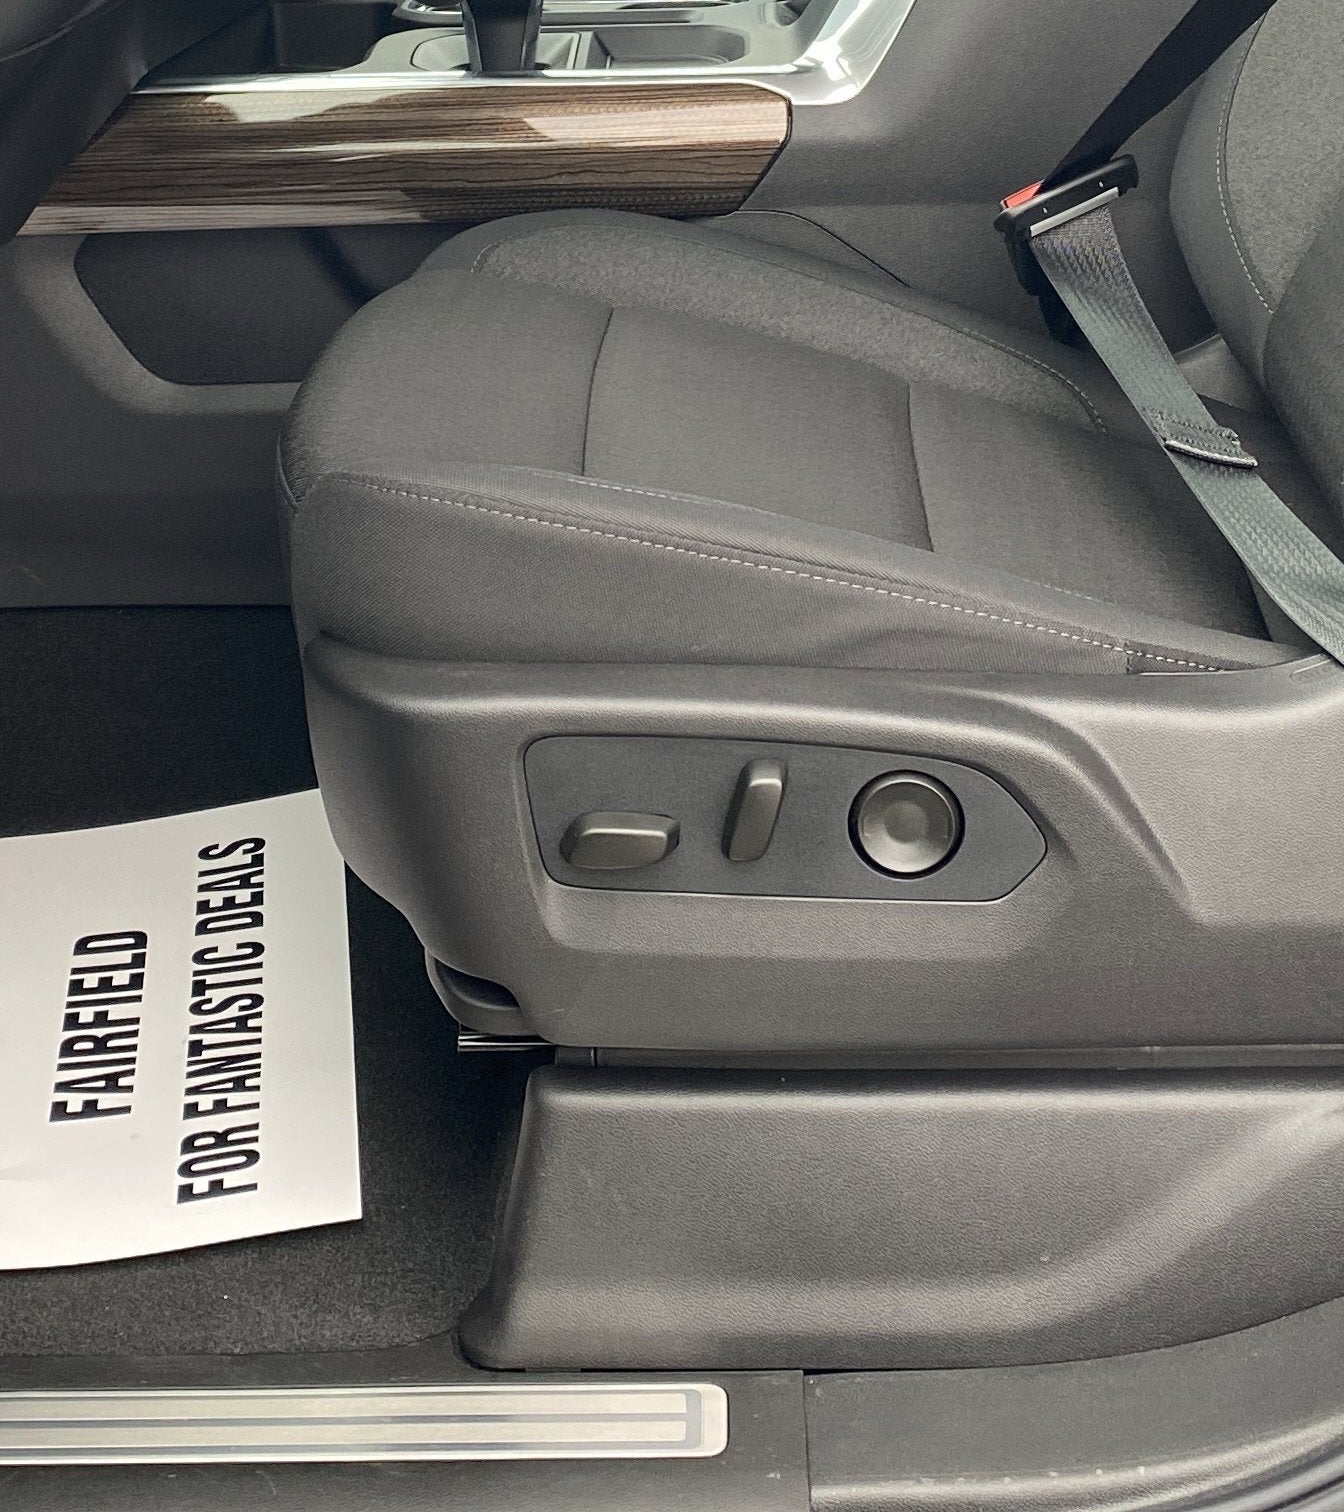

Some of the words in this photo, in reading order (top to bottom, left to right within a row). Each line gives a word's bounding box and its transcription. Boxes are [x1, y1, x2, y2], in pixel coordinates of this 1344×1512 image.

[194, 837, 266, 937] DEALS
[49, 929, 148, 1123] FAIRFIELD
[182, 941, 266, 1121] FANTASTIC
[176, 1121, 261, 1205] FOR
